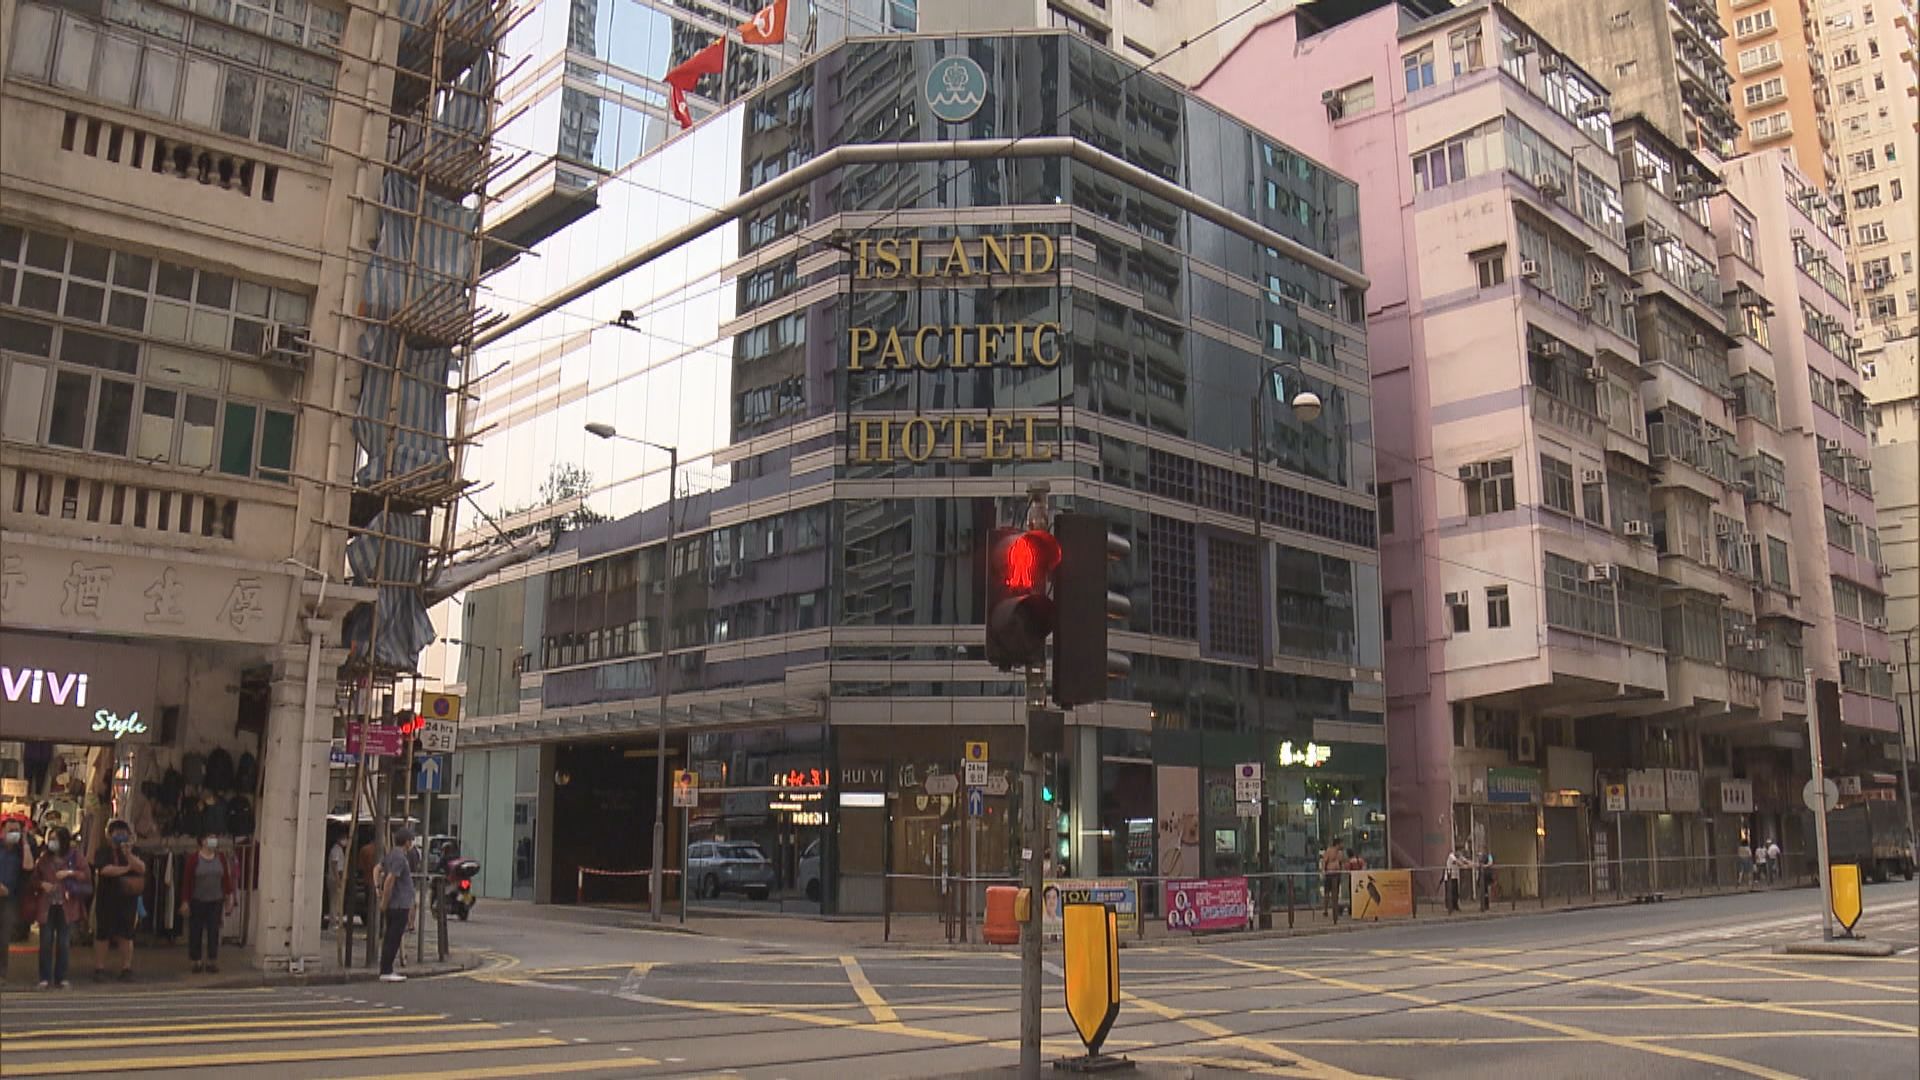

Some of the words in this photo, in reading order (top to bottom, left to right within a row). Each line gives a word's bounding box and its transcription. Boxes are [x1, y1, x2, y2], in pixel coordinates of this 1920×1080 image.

[856, 233, 1054, 280] ISLAND
[848, 321, 1062, 370] PACIFIC
[856, 416, 1053, 464] HOTEL
[1, 666, 89, 708] ViVi
[91, 708, 148, 740] Style
[425, 721, 438, 731] 24
[440, 724, 453, 733] hrs
[428, 734, 450, 749] 全日
[842, 769, 865, 784] HUI
[870, 769, 884, 784] YI
